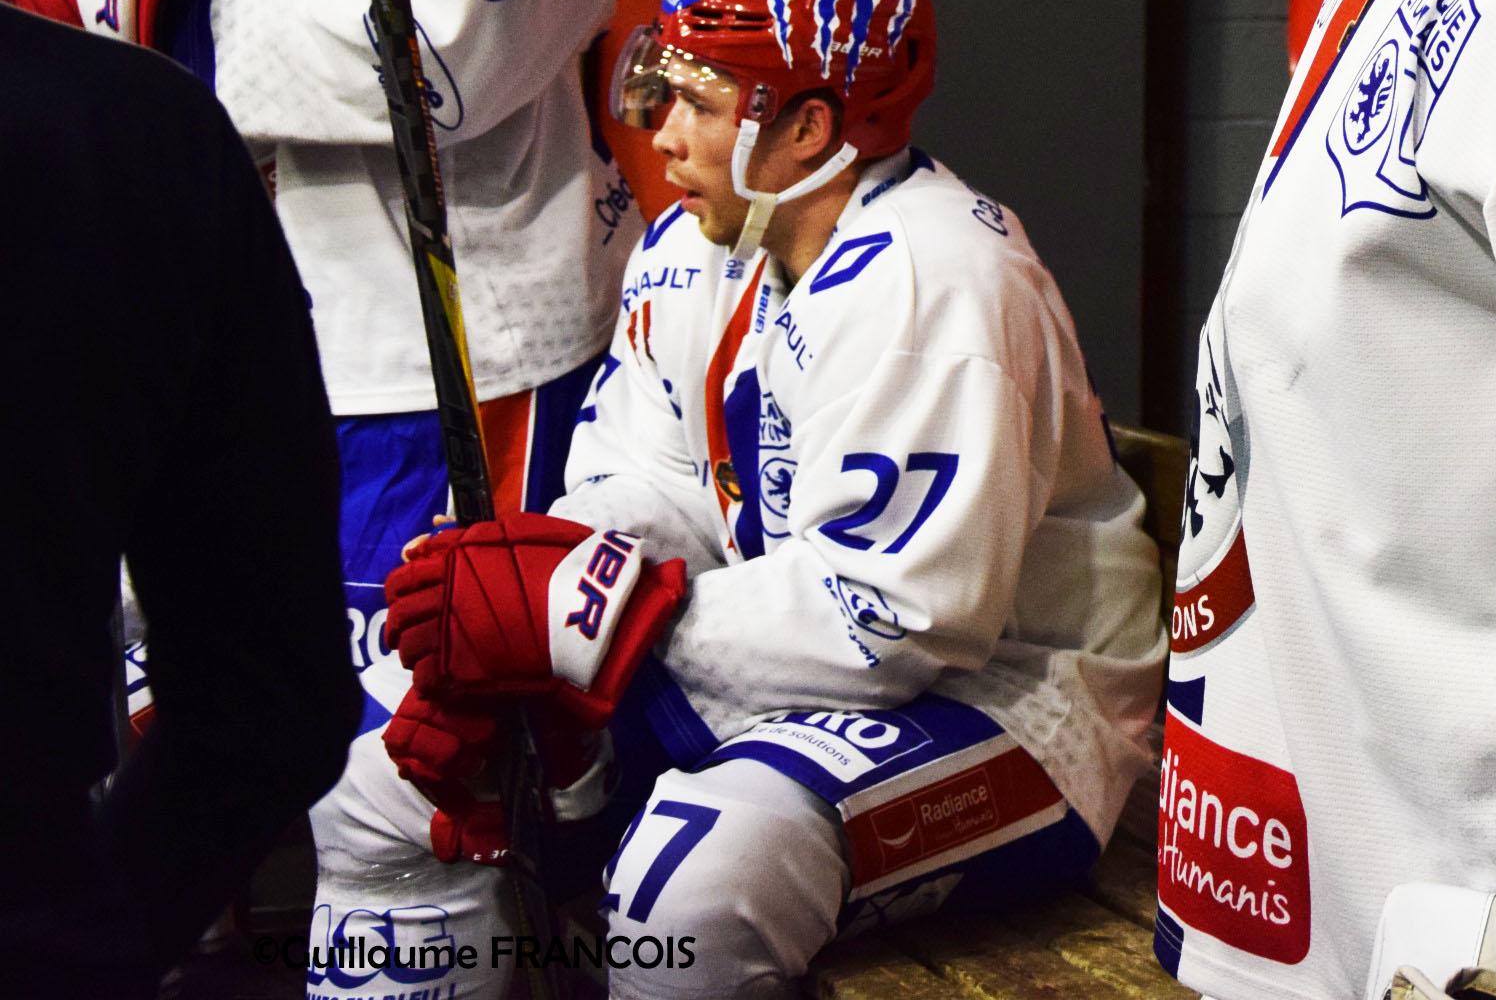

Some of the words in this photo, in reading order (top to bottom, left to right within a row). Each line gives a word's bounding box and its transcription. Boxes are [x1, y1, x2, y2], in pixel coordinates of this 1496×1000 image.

[818, 451, 960, 555] 27
[564, 529, 642, 641] UER
[790, 727, 852, 767] solutions
[919, 783, 989, 826] Radiance
[1159, 747, 1293, 868] diance
